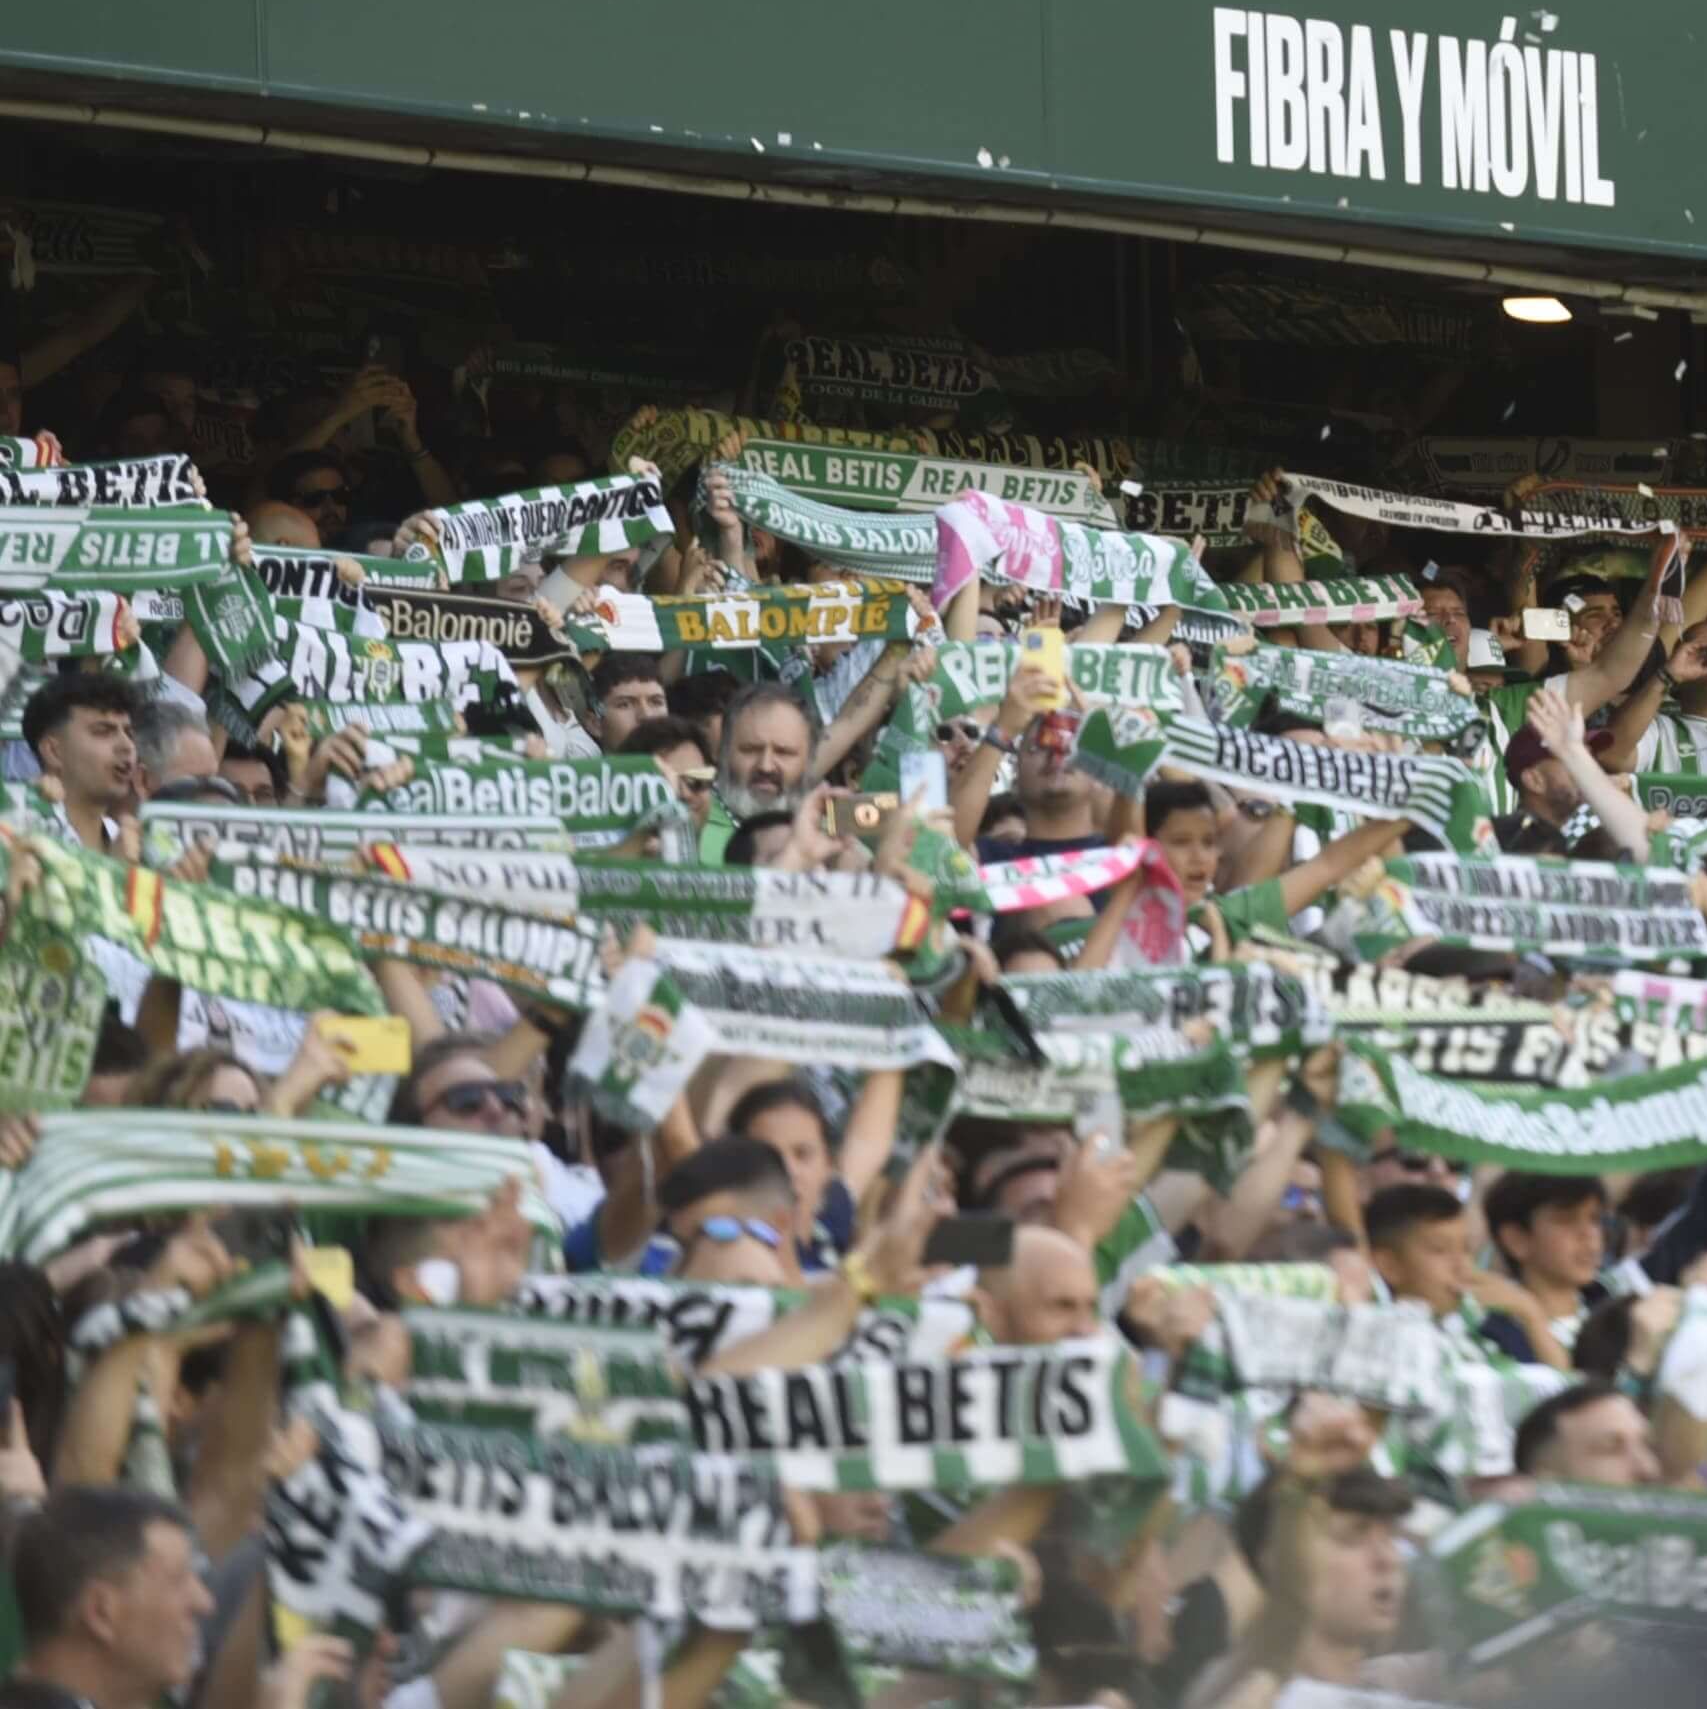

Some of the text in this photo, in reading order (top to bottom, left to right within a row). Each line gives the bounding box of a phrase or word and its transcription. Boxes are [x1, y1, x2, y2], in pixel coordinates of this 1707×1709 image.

[1213, 5, 1615, 207] FIBRA Y MÓVIL
[744, 447, 901, 489] REAL BETIS
[1002, 470, 1077, 504] BETIS
[520, 499, 568, 541] QUEDO
[772, 505, 841, 544] BETIS
[79, 531, 180, 567] BETIS
[676, 591, 890, 644] BALOMPIÉ
[690, 1355, 1098, 1452] REAL BETIS
